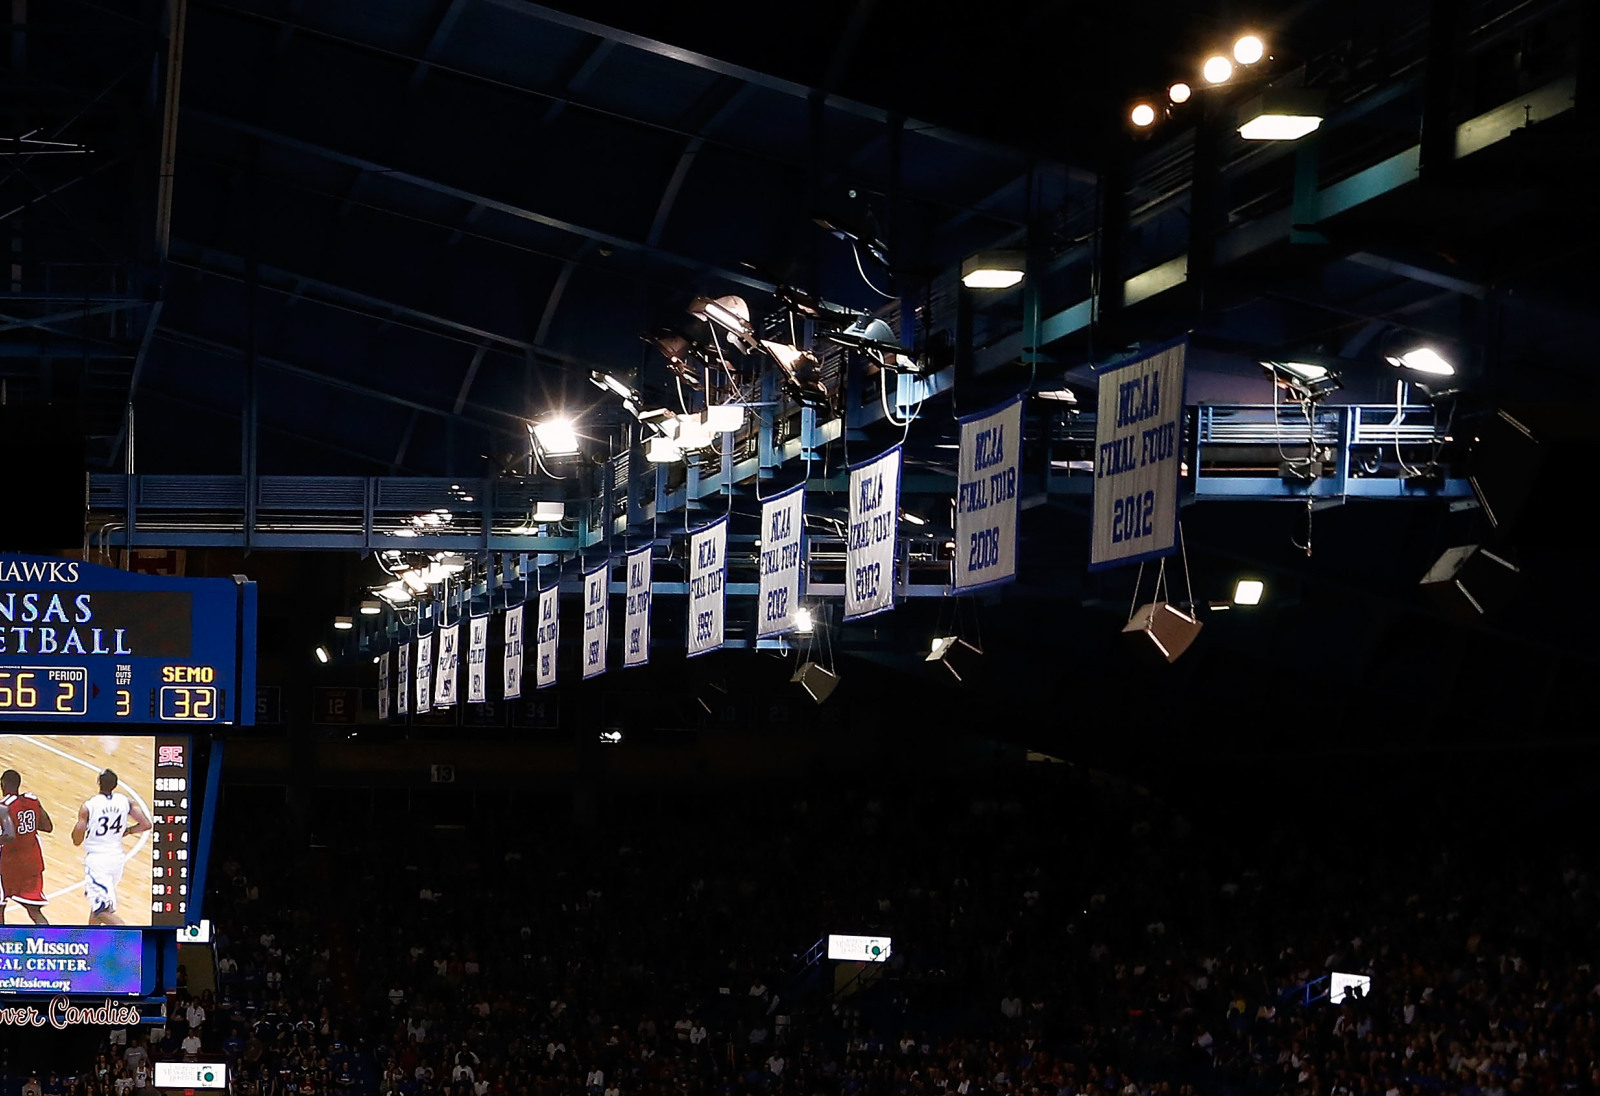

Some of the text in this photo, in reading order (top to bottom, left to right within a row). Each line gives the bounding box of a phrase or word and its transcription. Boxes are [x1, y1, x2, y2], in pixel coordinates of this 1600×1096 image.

[1117, 371, 1160, 428] NCAA
[974, 425, 1004, 471] NCAA
[1098, 422, 1175, 478] FINAL FOUR
[959, 467, 1015, 513] FINAL FOUR
[1112, 490, 1155, 543] 2012
[968, 526, 1000, 571] 2008
[48, 670, 83, 681] PERIOD
[162, 666, 214, 683] SEMO
[56, 682, 74, 711] 2
[116, 690, 130, 716] 3
[174, 689, 211, 717] 32
[159, 746, 182, 763] SE
[155, 778, 186, 791] SEMO
[17, 809, 36, 834] 33
[95, 814, 122, 836] 34
[153, 816, 165, 824] PL
[175, 816, 188, 824] PT
[168, 832, 173, 841] 1
[168, 850, 173, 859] 1
[167, 867, 172, 876] 1
[26, 937, 90, 956] MISSION
[28, 958, 91, 972] CENTER.
[48, 992, 141, 1030] Candies
